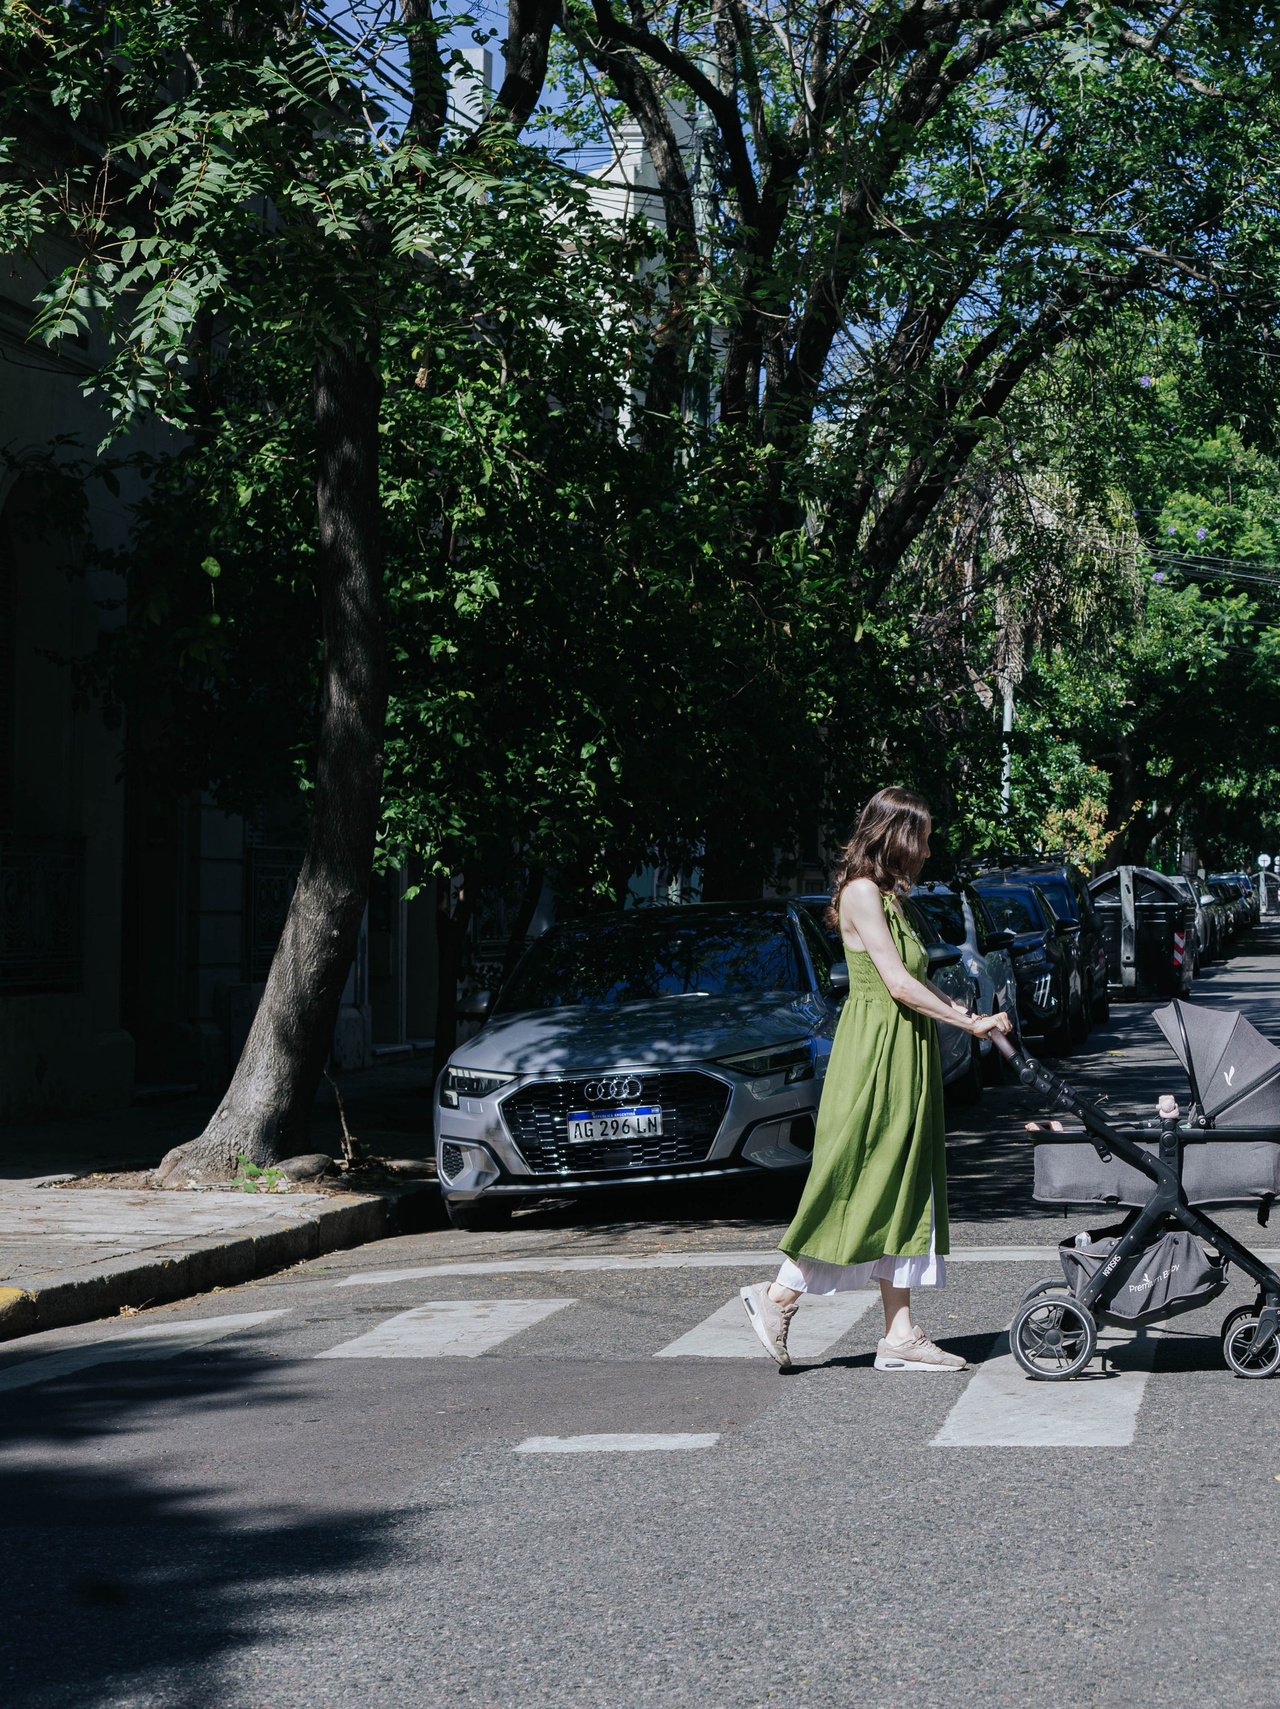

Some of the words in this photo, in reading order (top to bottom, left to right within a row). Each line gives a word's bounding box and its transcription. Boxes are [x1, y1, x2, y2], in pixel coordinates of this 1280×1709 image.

[574, 1122, 594, 1139] AG
[600, 1119, 631, 1136] 296
[637, 1117, 658, 1133] LN
[1102, 1254, 1122, 1277] KANSAS
[1162, 1264, 1180, 1279] Bby
